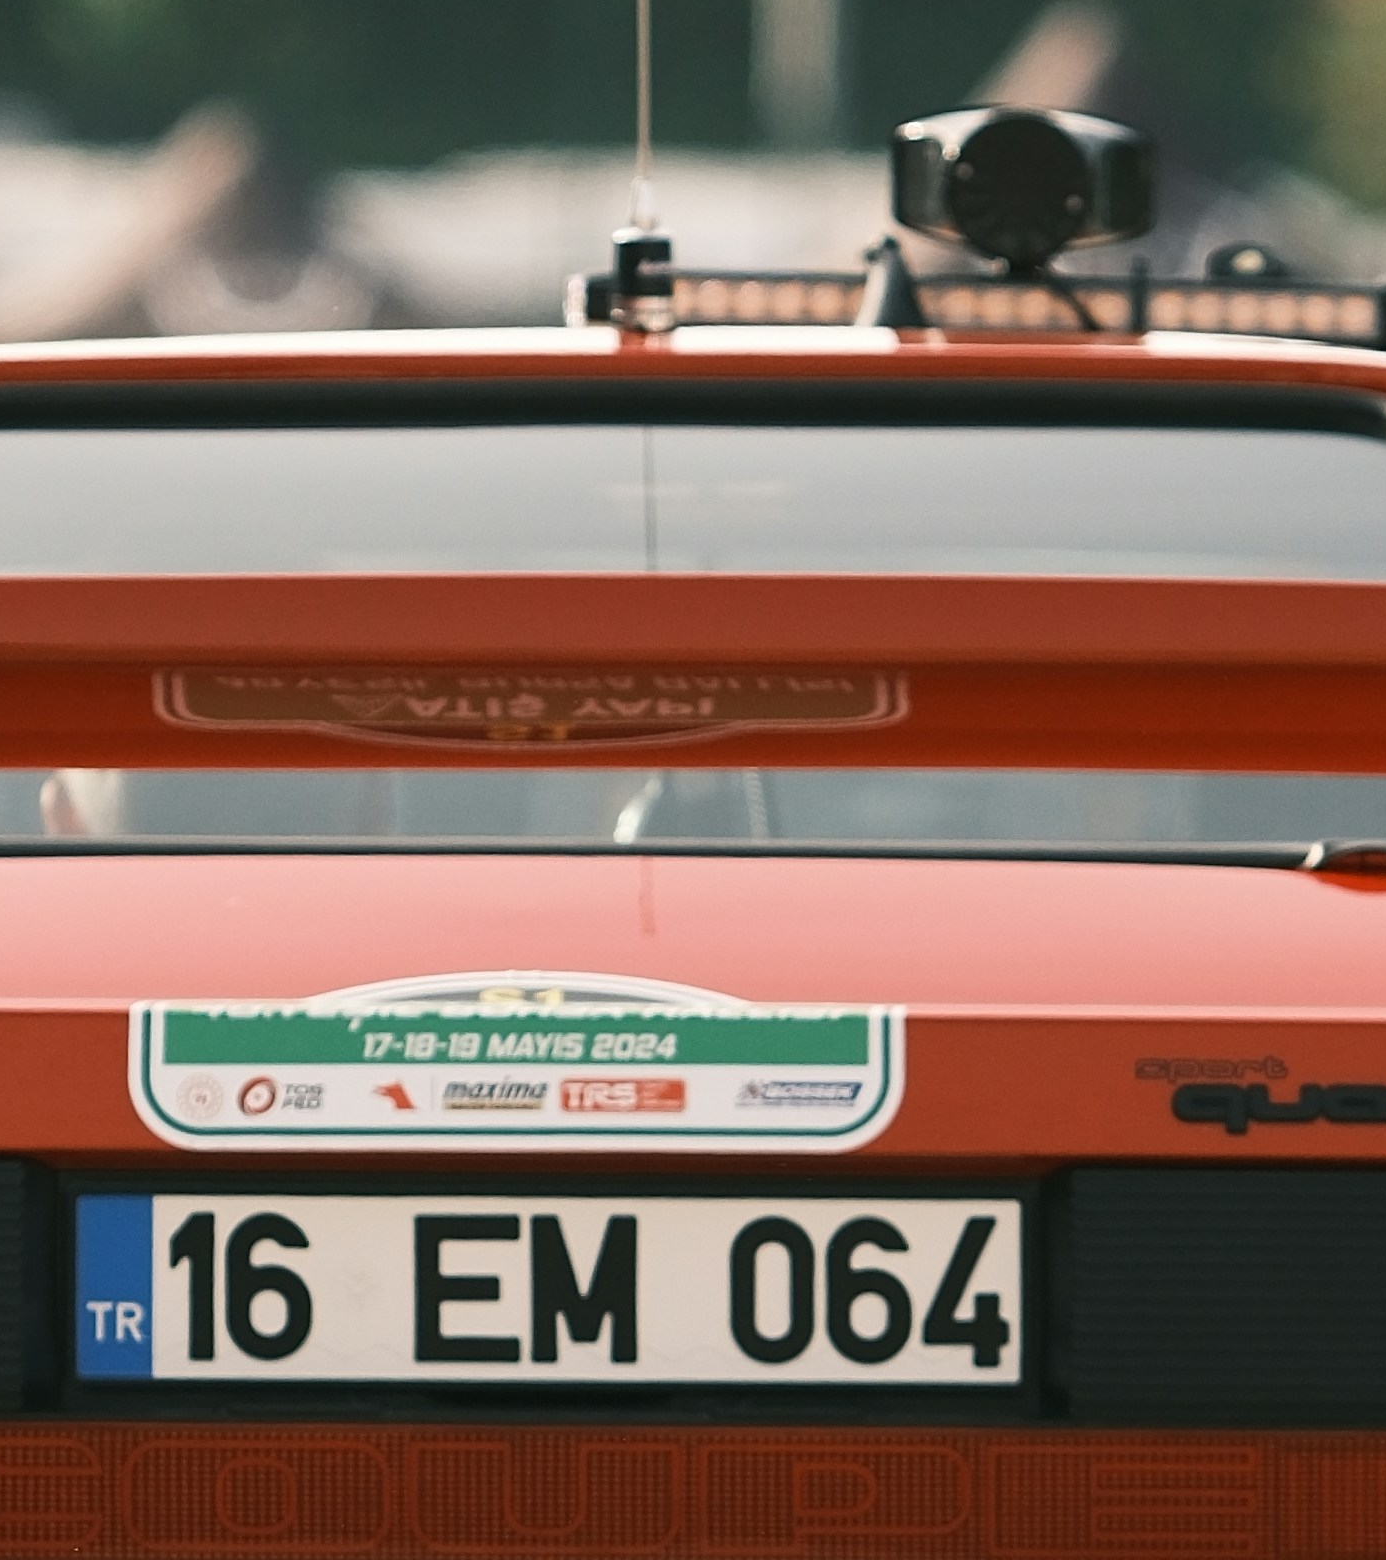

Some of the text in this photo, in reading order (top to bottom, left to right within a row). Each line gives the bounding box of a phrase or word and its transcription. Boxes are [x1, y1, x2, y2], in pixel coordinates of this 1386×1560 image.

[589, 1032, 678, 1060] 2024
[1134, 1056, 1288, 1083] sport
[443, 1076, 549, 1099] maxima
[564, 1081, 637, 1110] TRS
[169, 1211, 1010, 1366] 16 EM 064
[86, 1301, 147, 1342] TR
